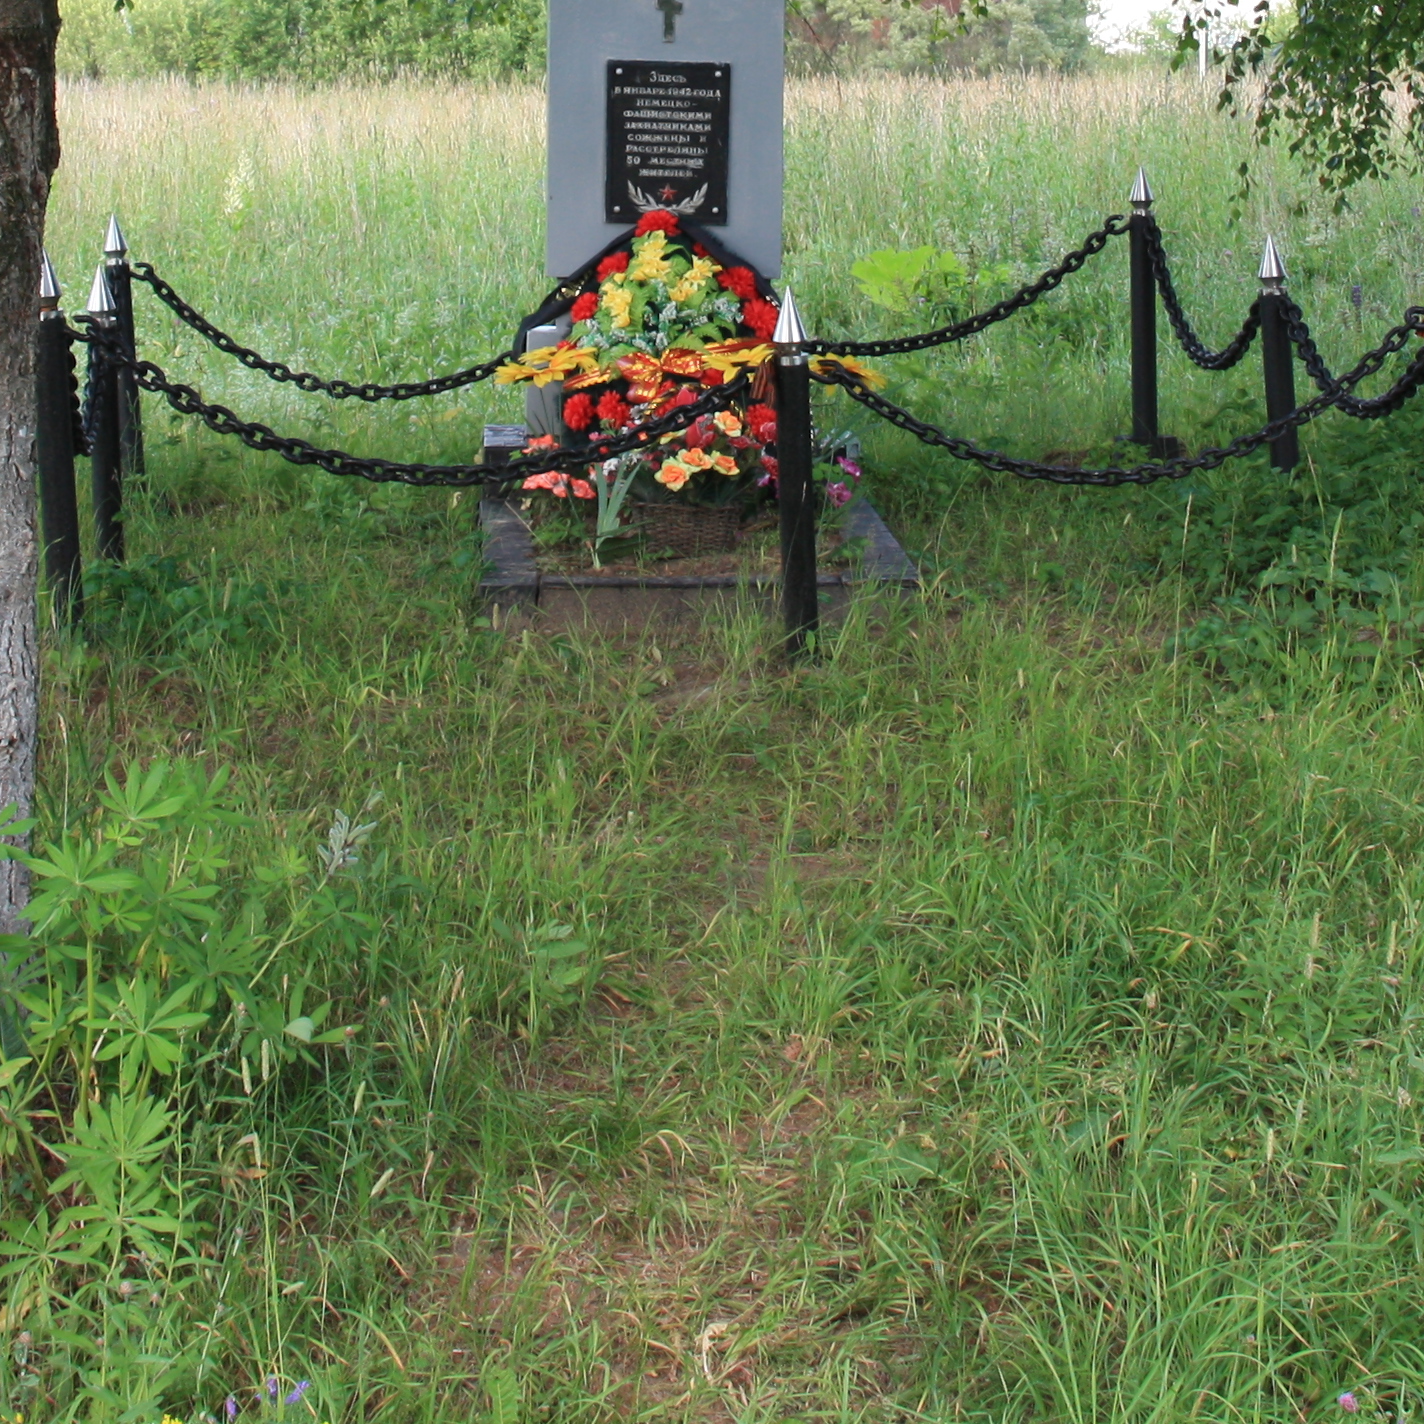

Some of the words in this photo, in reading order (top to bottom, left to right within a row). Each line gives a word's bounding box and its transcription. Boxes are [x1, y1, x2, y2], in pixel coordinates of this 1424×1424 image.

[614, 86, 622, 94] В
[623, 86, 665, 95] ЯНВАРЕ
[667, 87, 692, 96] 1942
[693, 89, 722, 98] ГОДА
[627, 133, 690, 143] СОЖЖЕНЫ
[699, 135, 707, 143] И
[625, 144, 708, 155] РАССТРЕЛЯНЫ
[626, 155, 641, 165] 50
[648, 157, 704, 168] МЕСТНЫХ
